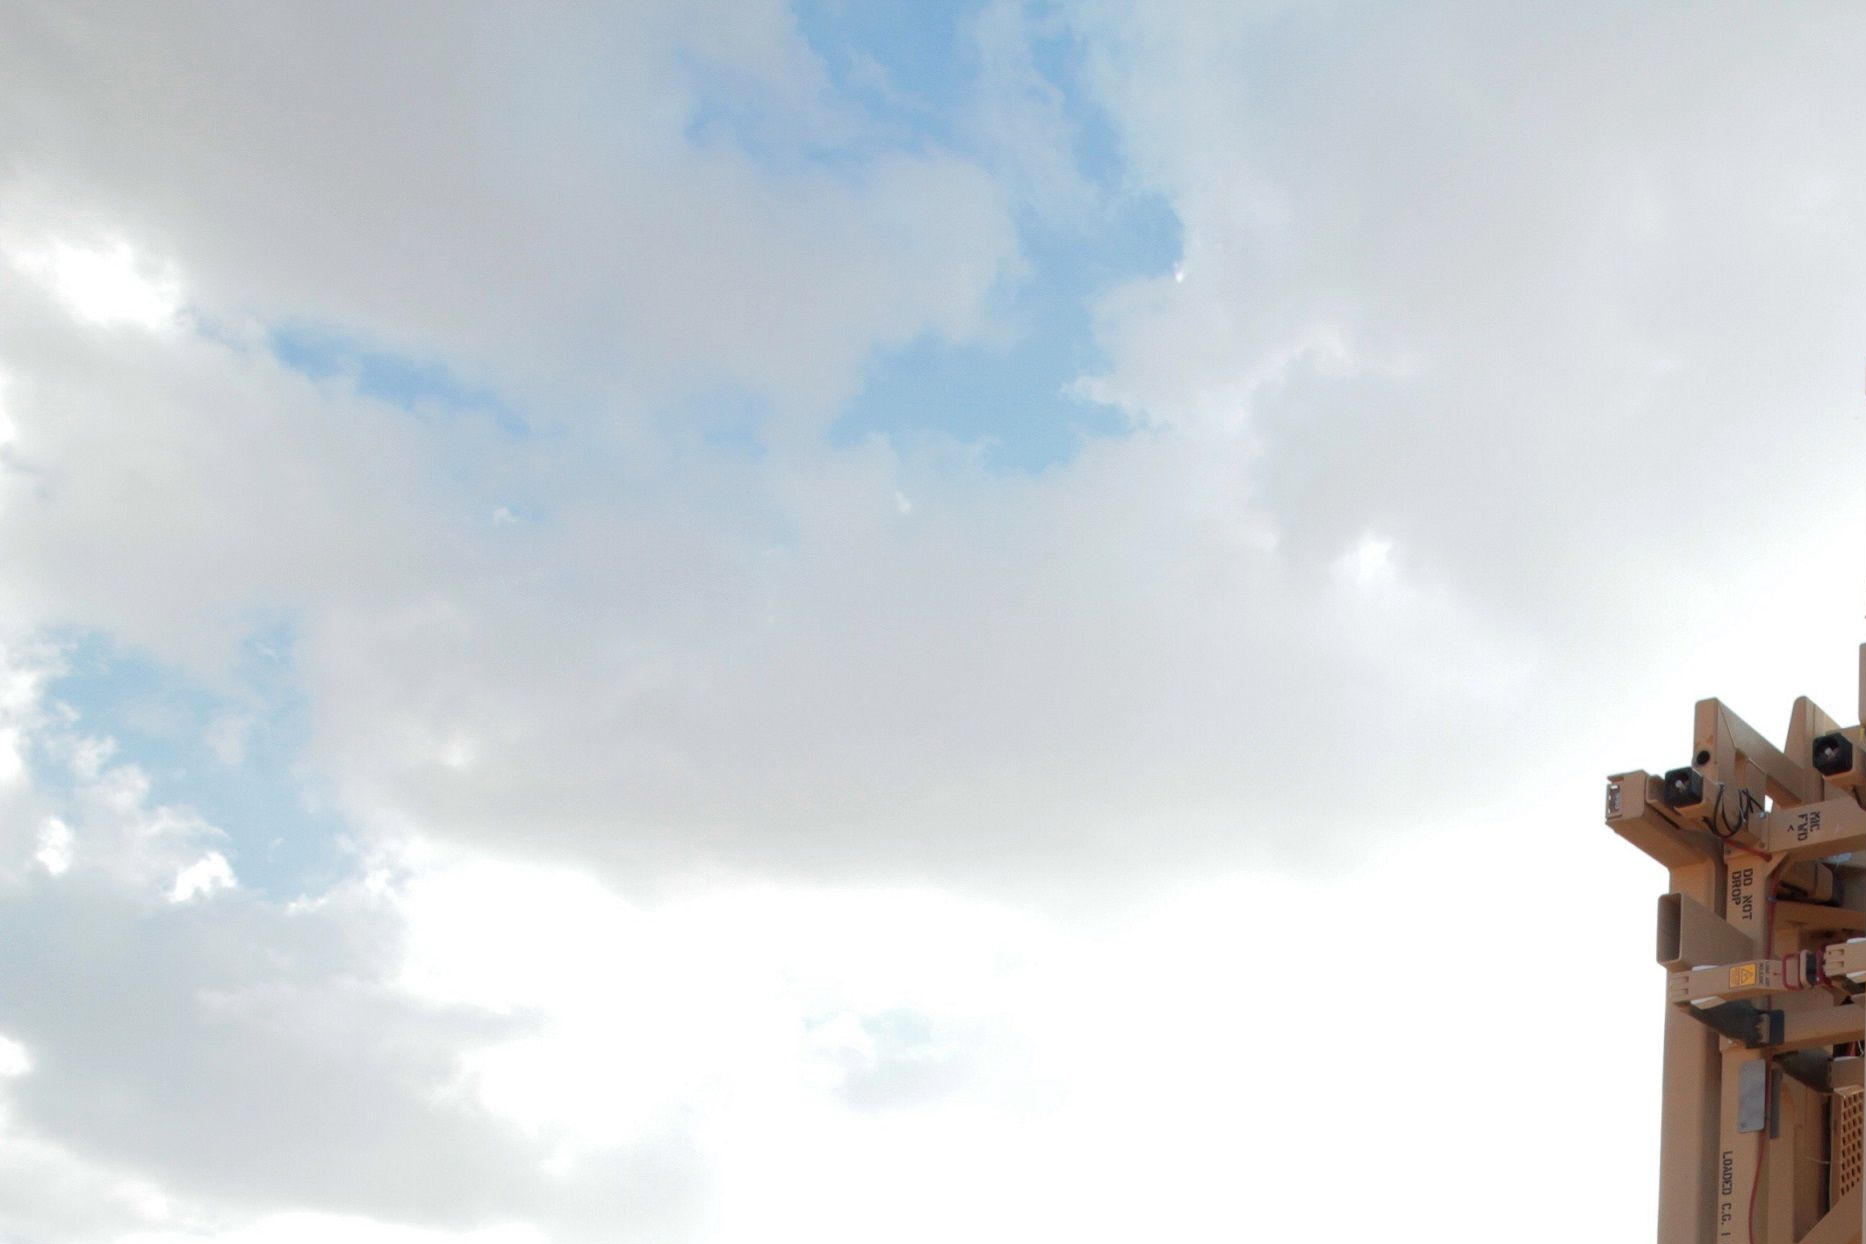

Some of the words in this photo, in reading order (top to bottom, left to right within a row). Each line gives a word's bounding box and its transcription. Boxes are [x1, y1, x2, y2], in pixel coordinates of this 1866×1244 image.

[1731, 870, 1742, 905] DROP
[1743, 868, 1753, 887] DO
[1742, 895, 1753, 920] NOT
[1722, 1150, 1733, 1196] LOADED
